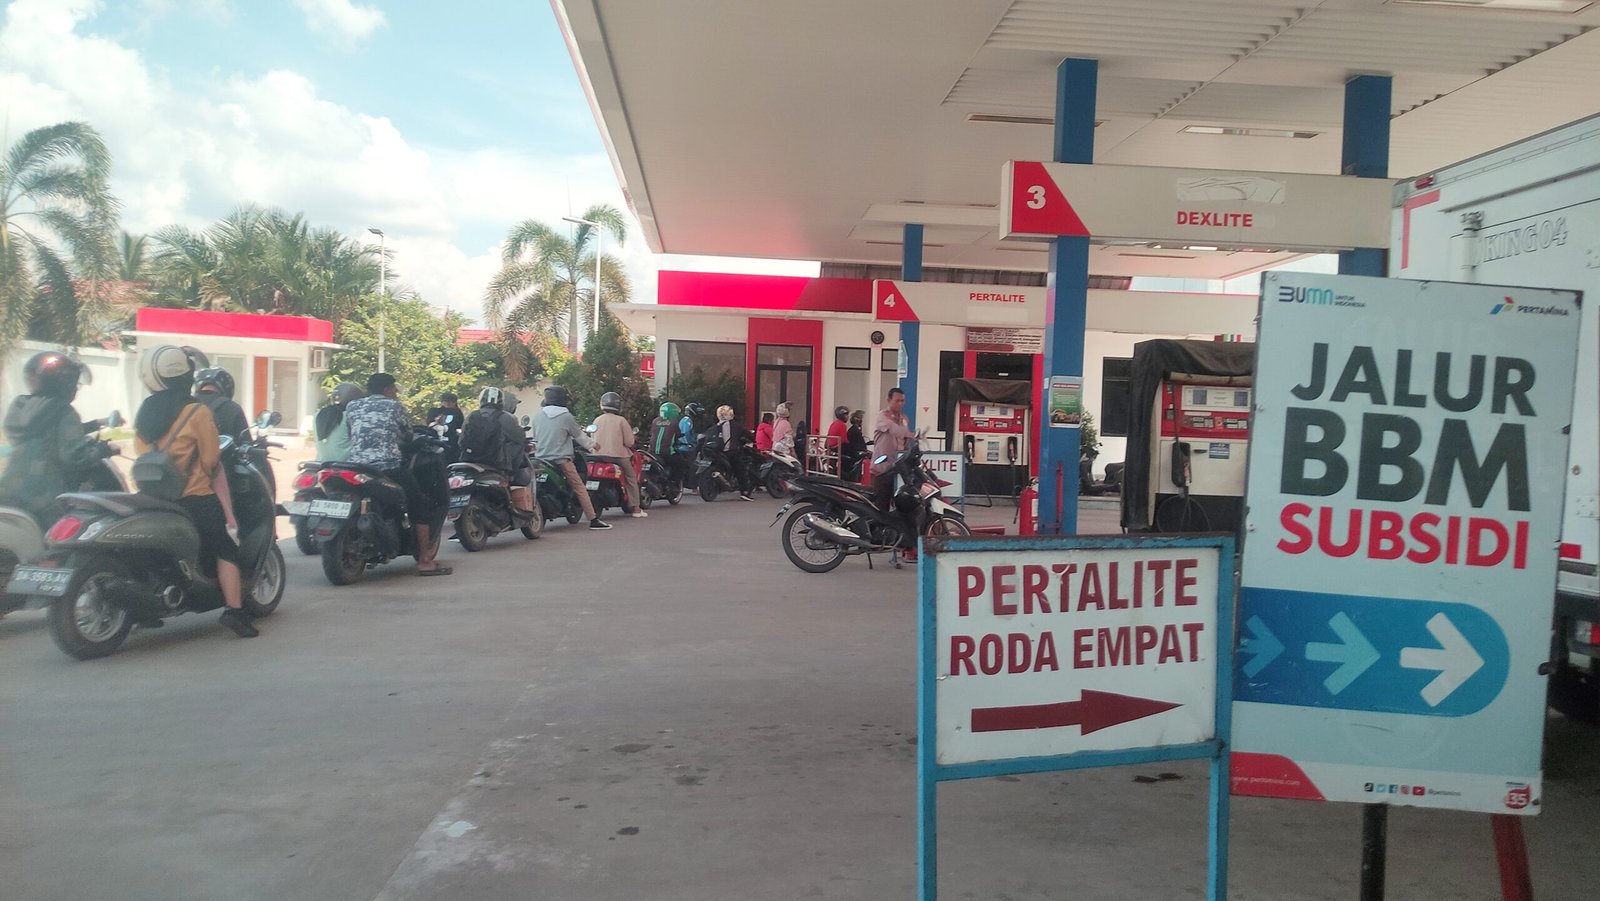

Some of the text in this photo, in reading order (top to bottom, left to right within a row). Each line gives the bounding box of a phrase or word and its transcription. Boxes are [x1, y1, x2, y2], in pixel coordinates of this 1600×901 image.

[1026, 185, 1047, 210] 3
[1176, 211, 1254, 228] DEXLITE
[883, 293, 896, 308] 4
[969, 292, 1025, 303] PERTALITE
[1517, 304, 1569, 317] PERTAMINA
[1290, 342, 1537, 417] JALUR
[1279, 406, 1532, 512] BBM
[1276, 502, 1530, 570] SUBSIDI
[957, 558, 1199, 617] PERTALITE
[950, 623, 1205, 676] RODA EMPAT
